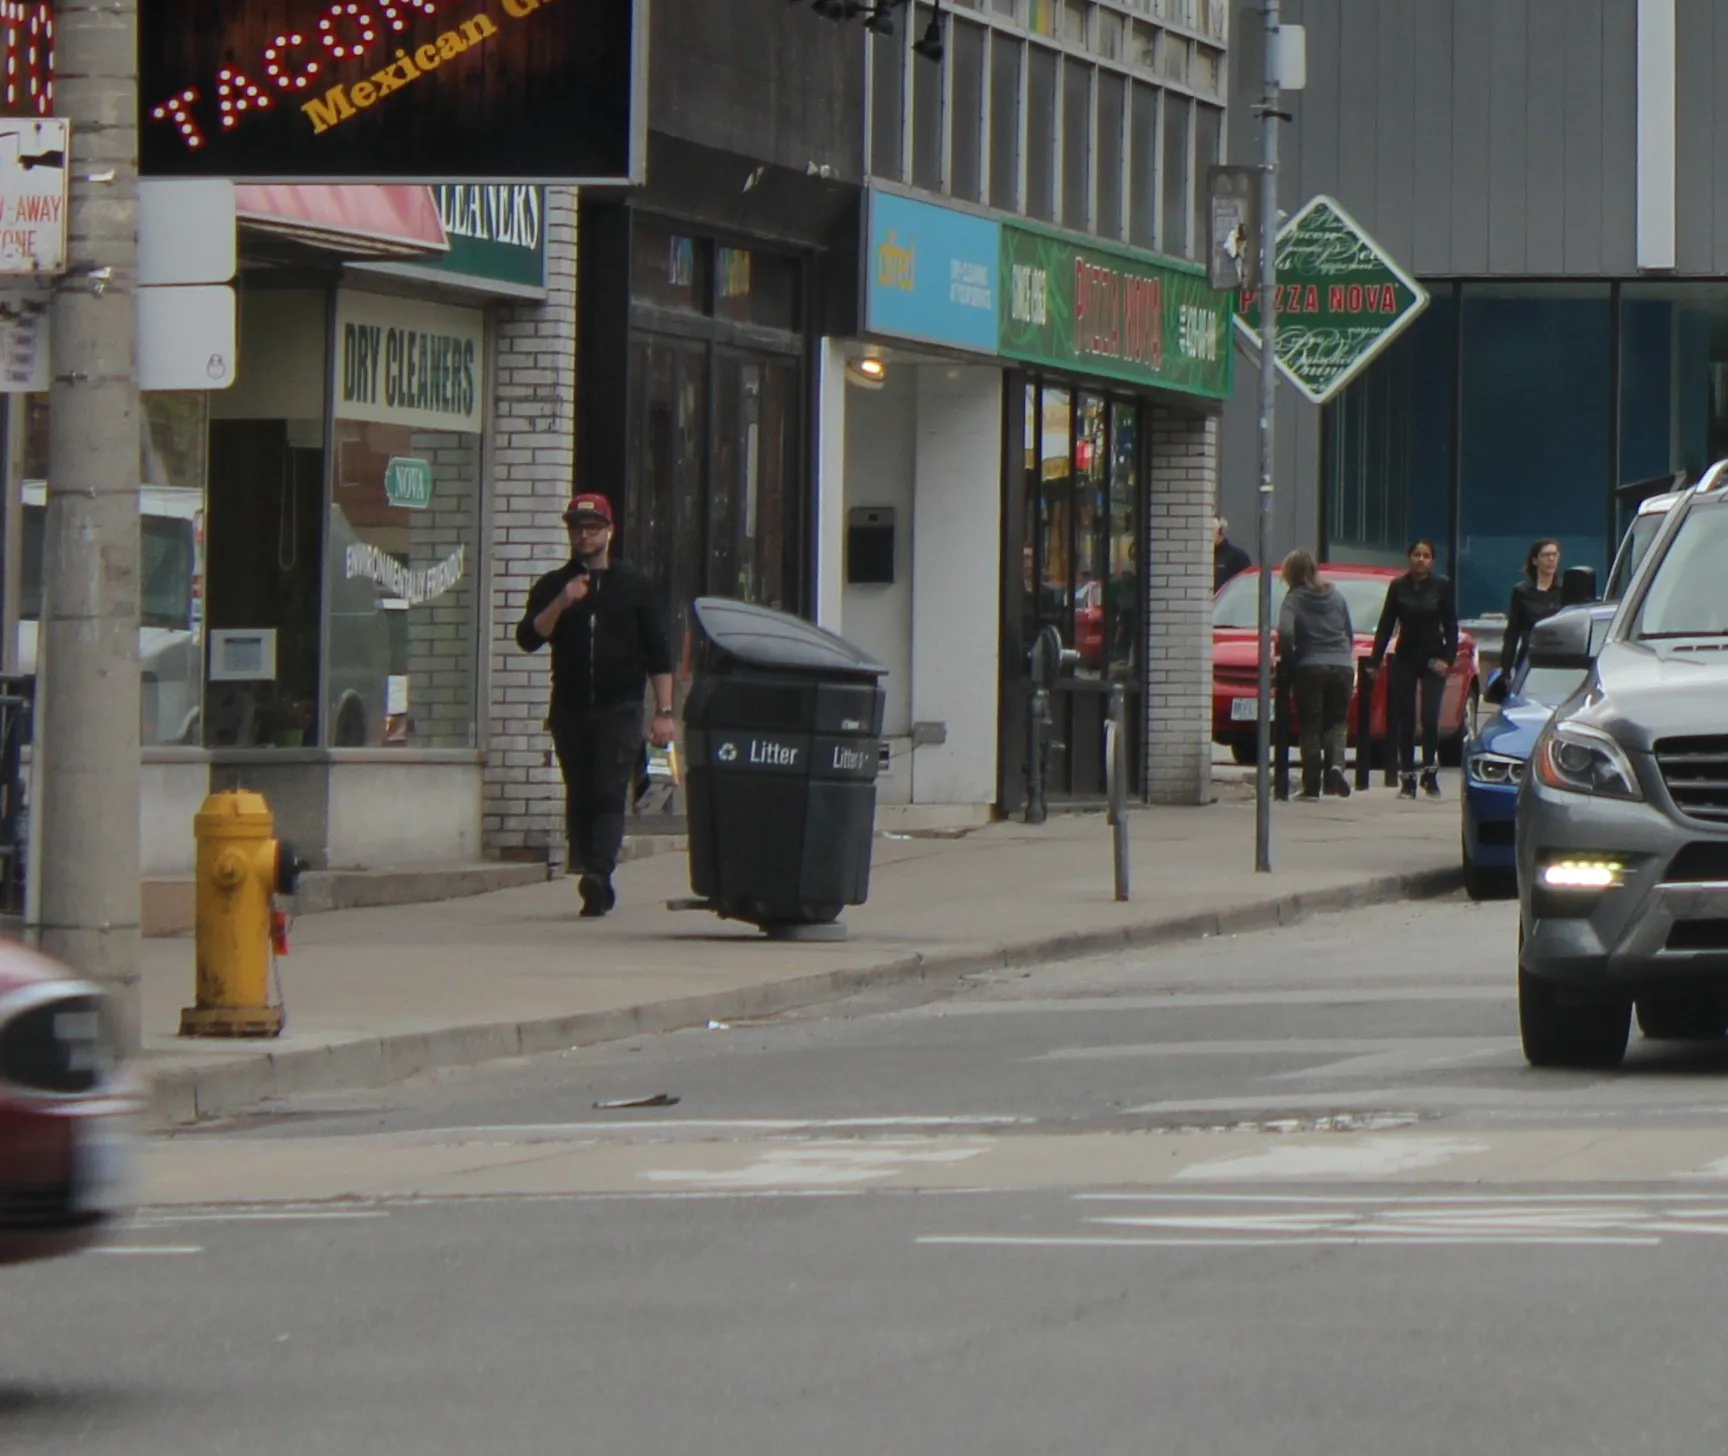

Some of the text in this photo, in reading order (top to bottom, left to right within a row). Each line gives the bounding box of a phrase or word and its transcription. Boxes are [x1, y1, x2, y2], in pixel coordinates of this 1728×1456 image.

[300, 12, 498, 136] Mexican
[440, 184, 541, 251] LEANERS
[0, 228, 38, 259] ONE
[1073, 256, 1119, 358] PIZZA
[1123, 273, 1161, 373] NOVA
[1240, 284, 1397, 314] PZZA NOVA
[343, 322, 474, 419] DRY CLEANERS
[394, 466, 425, 501] NOVA
[750, 739, 799, 766] Litter
[832, 745, 857, 770] Litter
